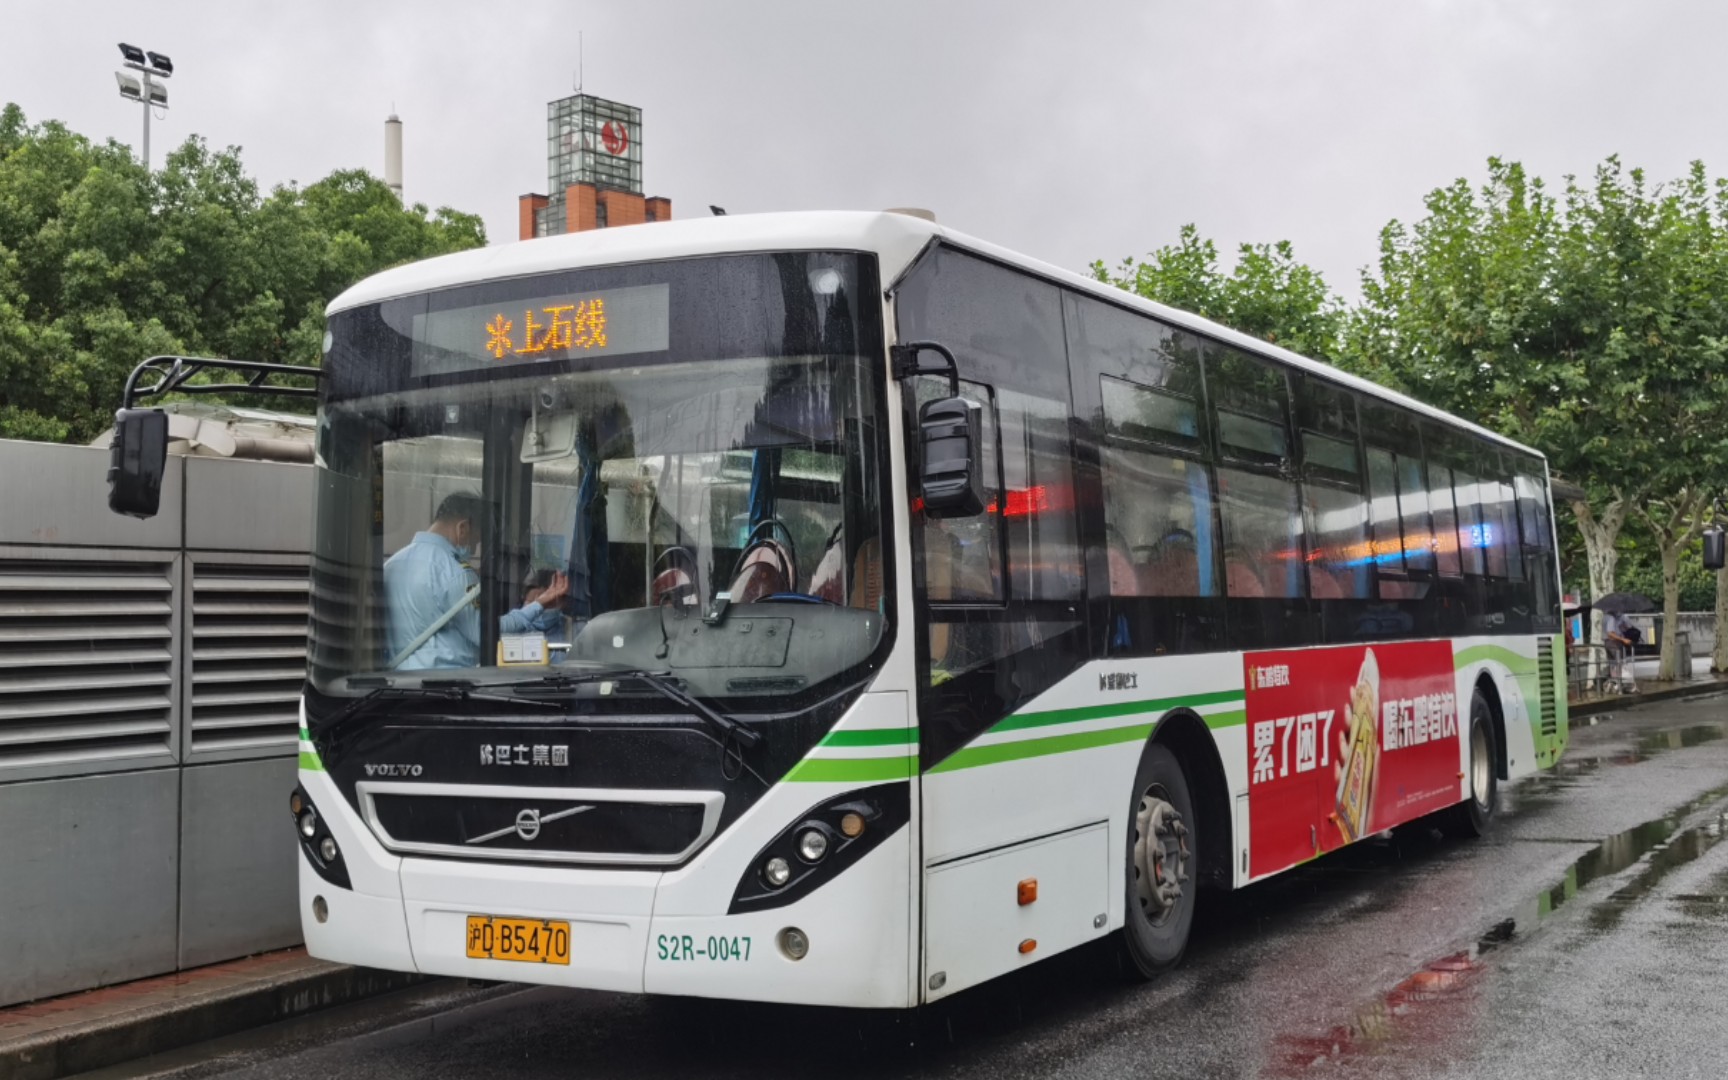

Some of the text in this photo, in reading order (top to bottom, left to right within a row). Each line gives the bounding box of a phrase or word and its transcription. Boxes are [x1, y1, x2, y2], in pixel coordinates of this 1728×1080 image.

[1253, 709, 1335, 785] 累了困了
[1383, 691, 1457, 752] 喝东鹏特饮
[364, 764, 423, 776] VOLVO
[657, 934, 751, 961] S2R-0047
